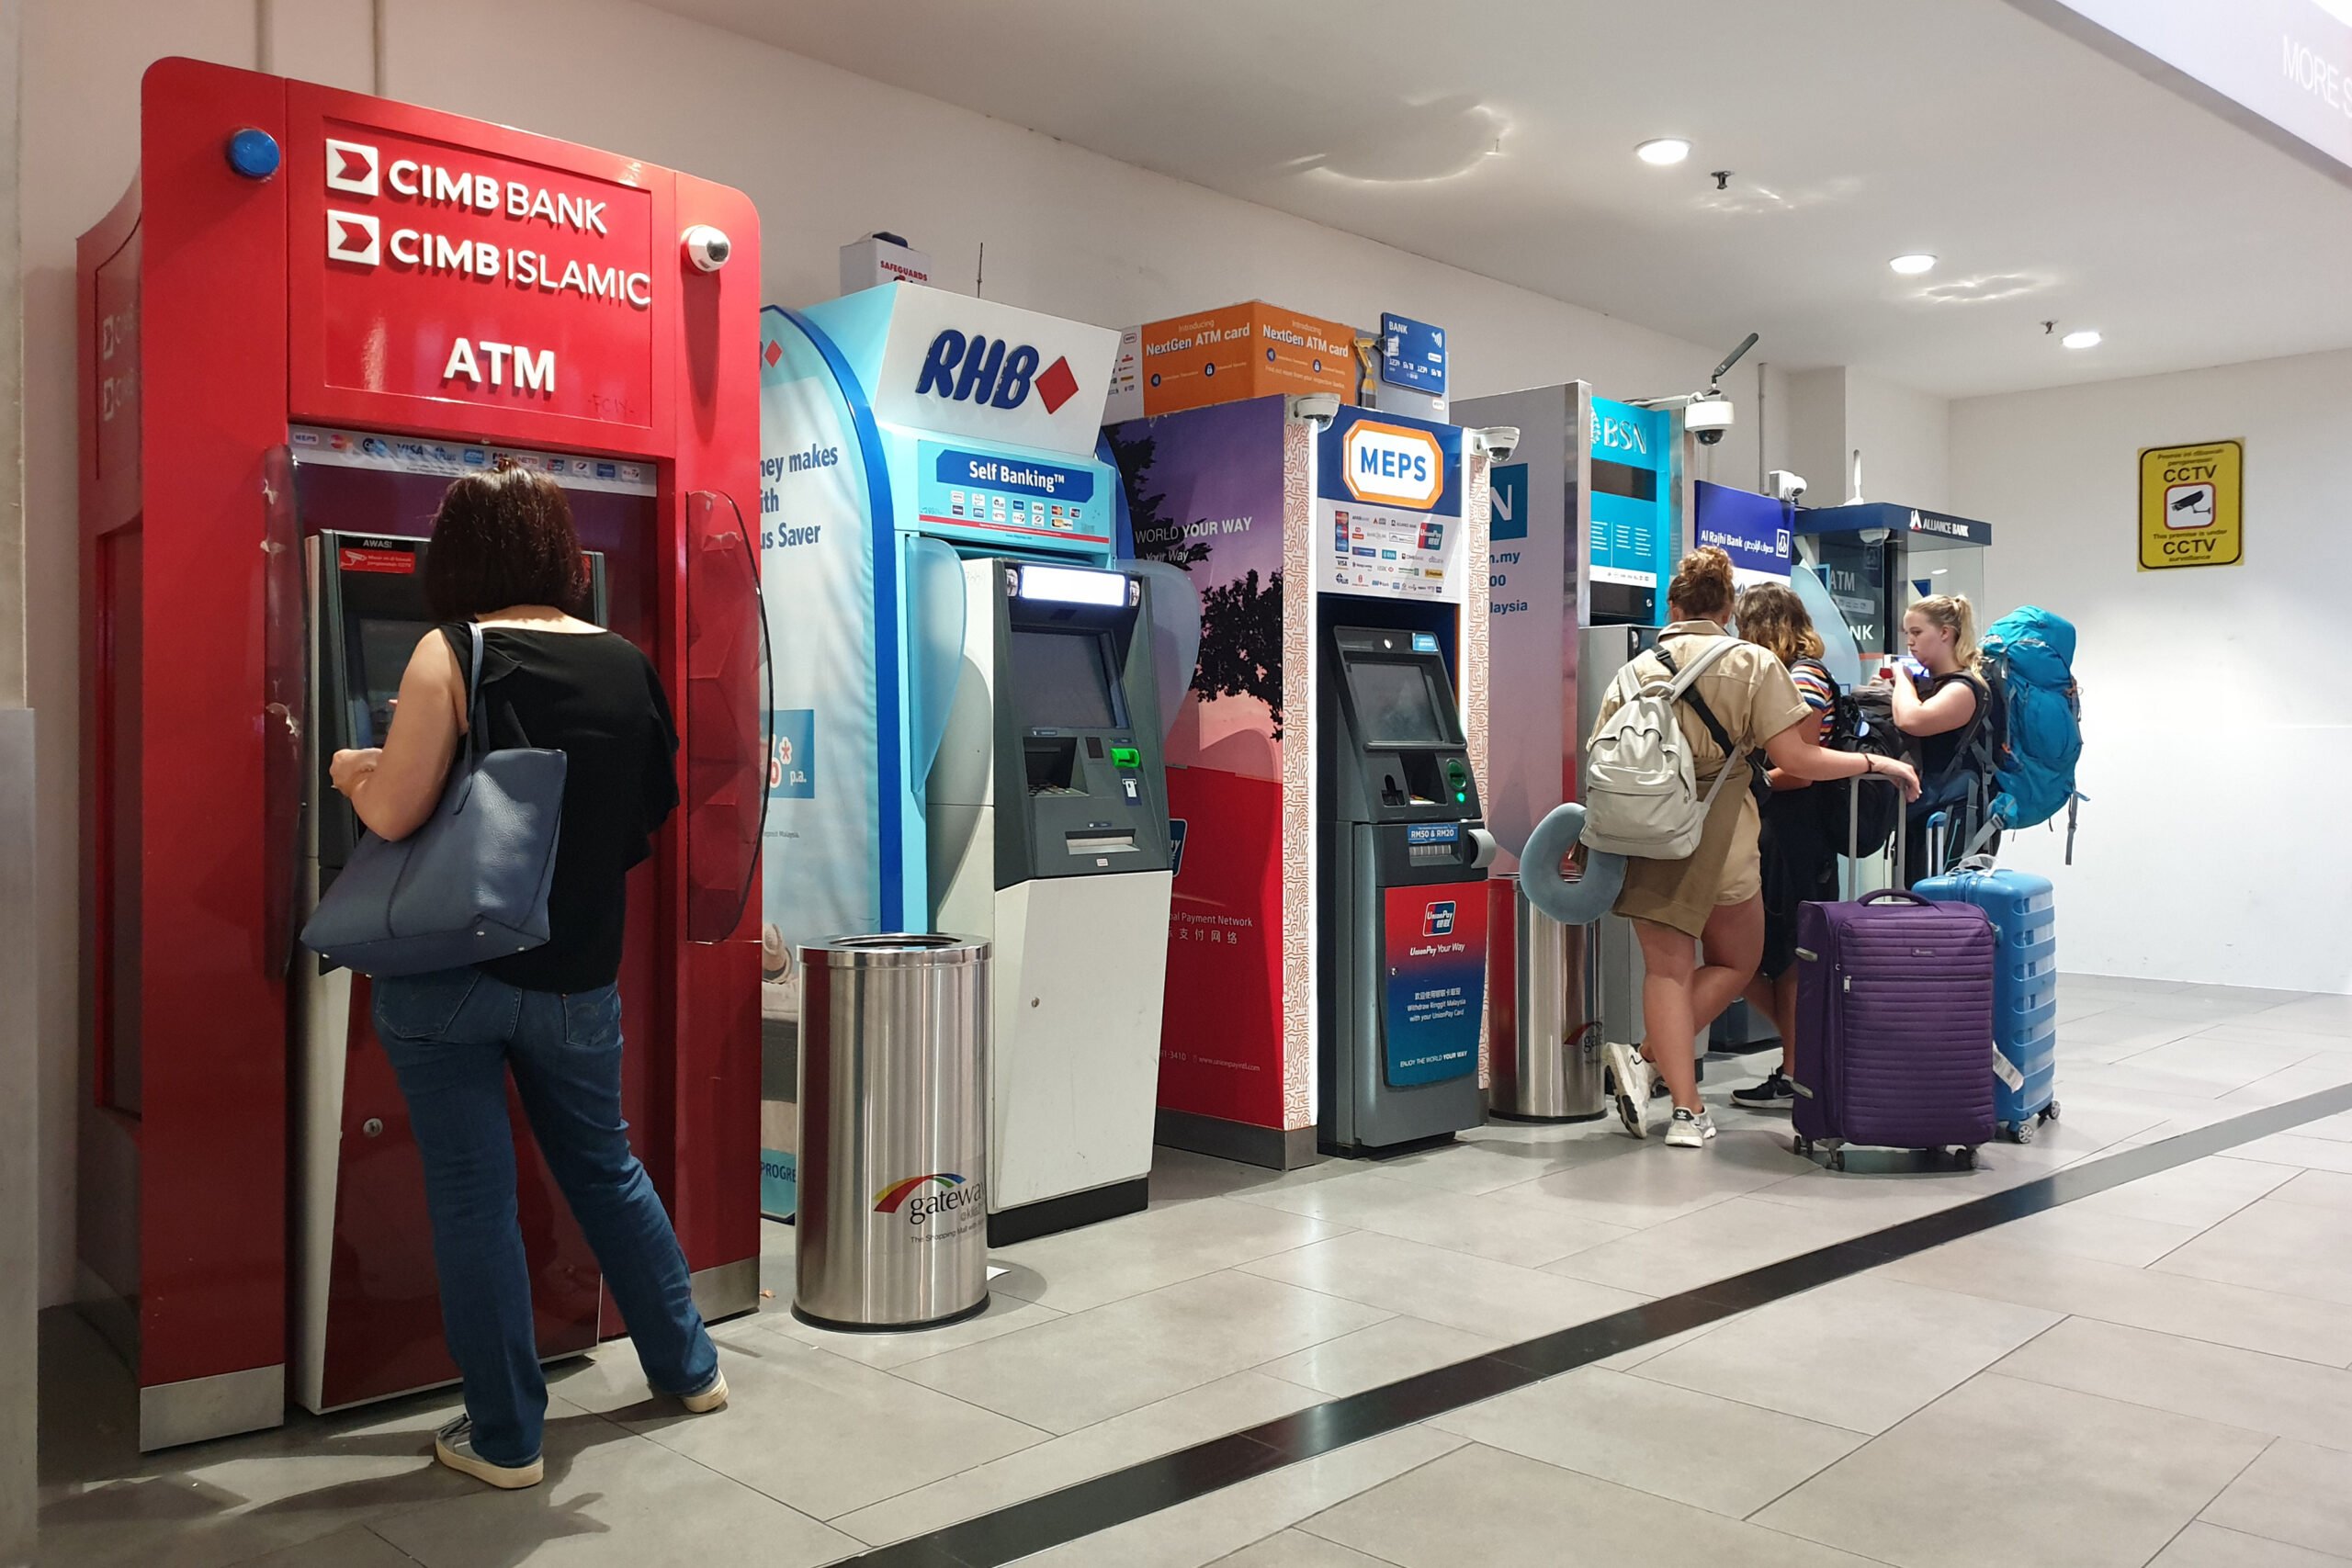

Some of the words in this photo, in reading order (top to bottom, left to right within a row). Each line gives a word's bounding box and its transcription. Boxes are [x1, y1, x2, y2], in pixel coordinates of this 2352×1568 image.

[2283, 34, 2340, 109] MORE
[389, 159, 500, 210] CIMB
[506, 182, 608, 234] BANK
[390, 229, 501, 276] CIMB
[507, 248, 651, 305] ISLAMIC
[880, 260, 928, 282] SAFEGUARDS
[1179, 320, 1215, 333] Introducing
[1388, 321, 1408, 334] BANK
[1146, 337, 1193, 356] NextGen
[1195, 329, 1221, 346] ATM
[1225, 322, 1250, 341] card
[1263, 323, 1304, 346] NextGen
[1306, 335, 1327, 352] ATM
[1329, 344, 1349, 358] card
[443, 337, 555, 392] ATM
[915, 328, 1040, 411] RHB
[1603, 416, 1647, 455] BSN
[397, 443, 424, 456] VISA
[760, 457, 784, 482] ney
[788, 443, 838, 473] makes
[969, 461, 997, 481] Self
[1360, 446, 1427, 482] MEPS
[2163, 465, 2217, 483] CCTV
[761, 487, 779, 513] ith
[761, 532, 774, 549] us
[778, 522, 821, 547] Saver
[1135, 526, 1179, 544] WORLD
[1182, 522, 1217, 538] YOUR
[1222, 516, 1252, 534] WAY
[1923, 518, 1951, 535] ALLIANCE
[1951, 523, 1969, 537] BANK
[1701, 530, 1709, 541] Al
[1709, 531, 1726, 546] Rajhi
[1726, 535, 1743, 547] Bank
[2163, 538, 2216, 555] CCTV
[1168, 550, 1189, 563] Way
[1490, 574, 1507, 586] 00
[1830, 570, 1855, 592] ATM
[1490, 600, 1528, 615] laysia
[1849, 624, 1874, 640] NK
[790, 770, 807, 786] p.a.
[1411, 829, 1430, 838] RM50
[1436, 829, 1454, 837] RM20
[1182, 912, 1216, 925] Payment
[1217, 915, 1252, 927] Network
[1427, 909, 1453, 921] UnionPay
[1409, 944, 1437, 957] UnionPay
[1437, 943, 1452, 953] Your
[1452, 942, 1465, 953] Way
[1408, 1003, 1430, 1011] Withdraw
[1447, 999, 1466, 1008] Malaysia
[1409, 1013, 1420, 1021] with
[1421, 1013, 1431, 1021] your
[1432, 1010, 1453, 1020] UnionPay
[1426, 1055, 1442, 1063] WORLD
[1442, 1052, 1456, 1060] YOUR
[1456, 1050, 1468, 1058] WAY
[761, 1161, 796, 1183] PROGRE
[910, 1235, 923, 1244] The
[925, 1230, 956, 1242] Shopping
